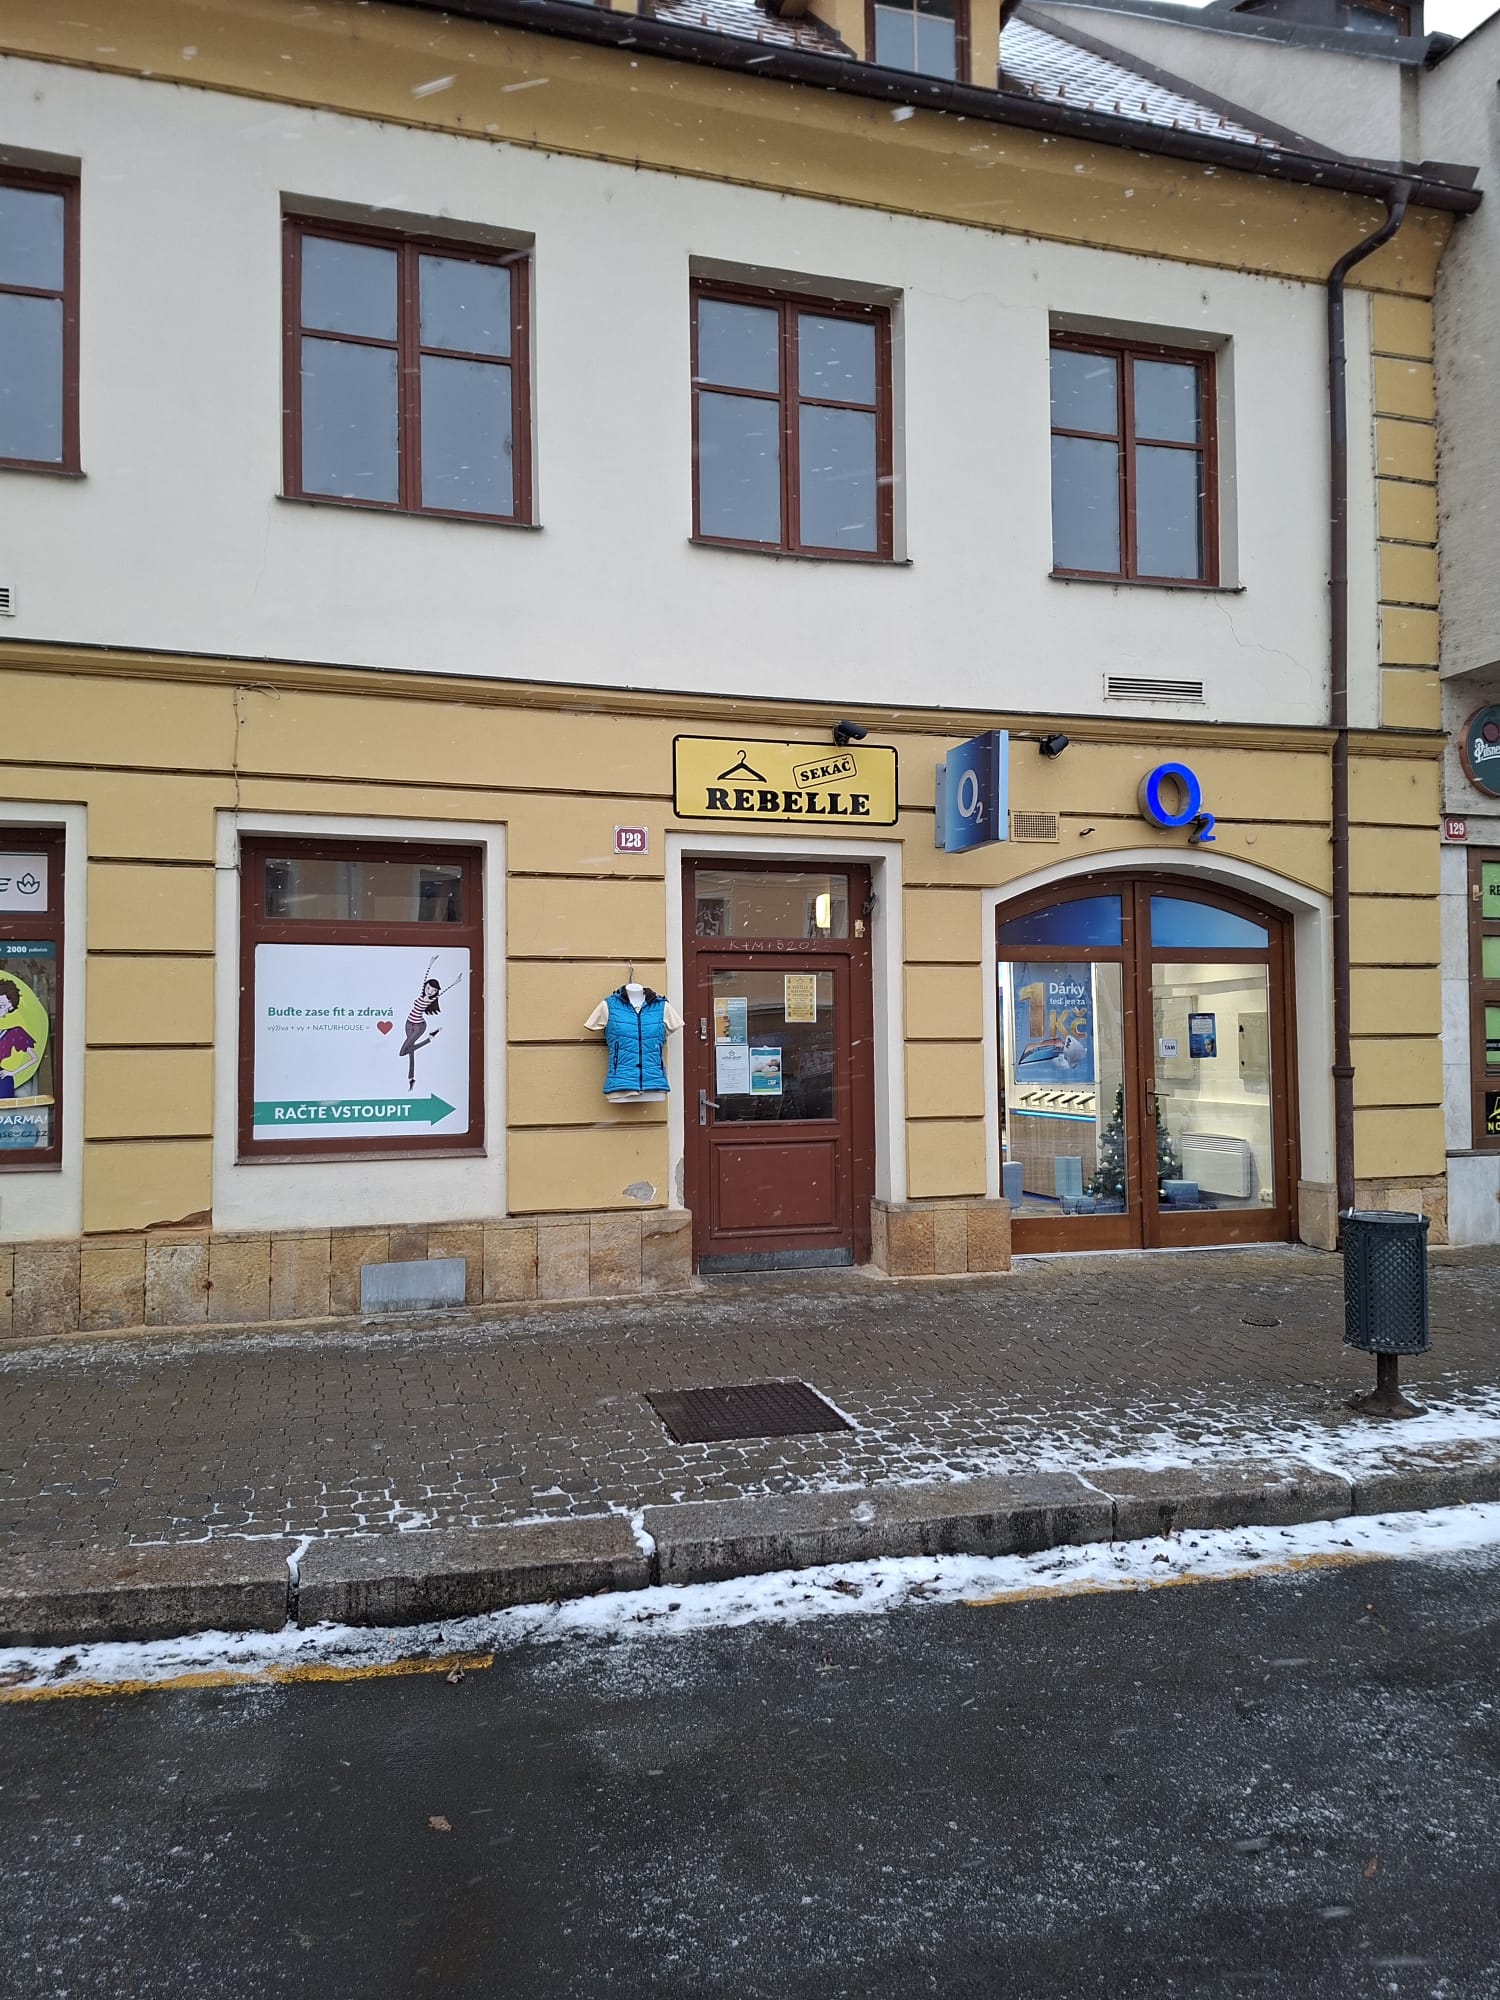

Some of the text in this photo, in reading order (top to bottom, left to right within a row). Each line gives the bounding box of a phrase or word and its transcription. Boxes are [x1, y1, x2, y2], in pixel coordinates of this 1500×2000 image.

[800, 757, 851, 782] SEKÁČ
[706, 787, 870, 816] REBELLE
[1449, 822, 1464, 835] 129
[620, 832, 642, 848] 128
[6, 945, 28, 953] 2000
[1049, 981, 1085, 997] Dárky
[1063, 998, 1076, 1006] jen
[267, 1006, 394, 1017] Buďte zase fit a zdravá
[1018, 982, 1087, 1039] 1 Kč
[267, 1024, 289, 1032] výživa
[274, 1104, 412, 1120] RAČTE VSTOUPIT
